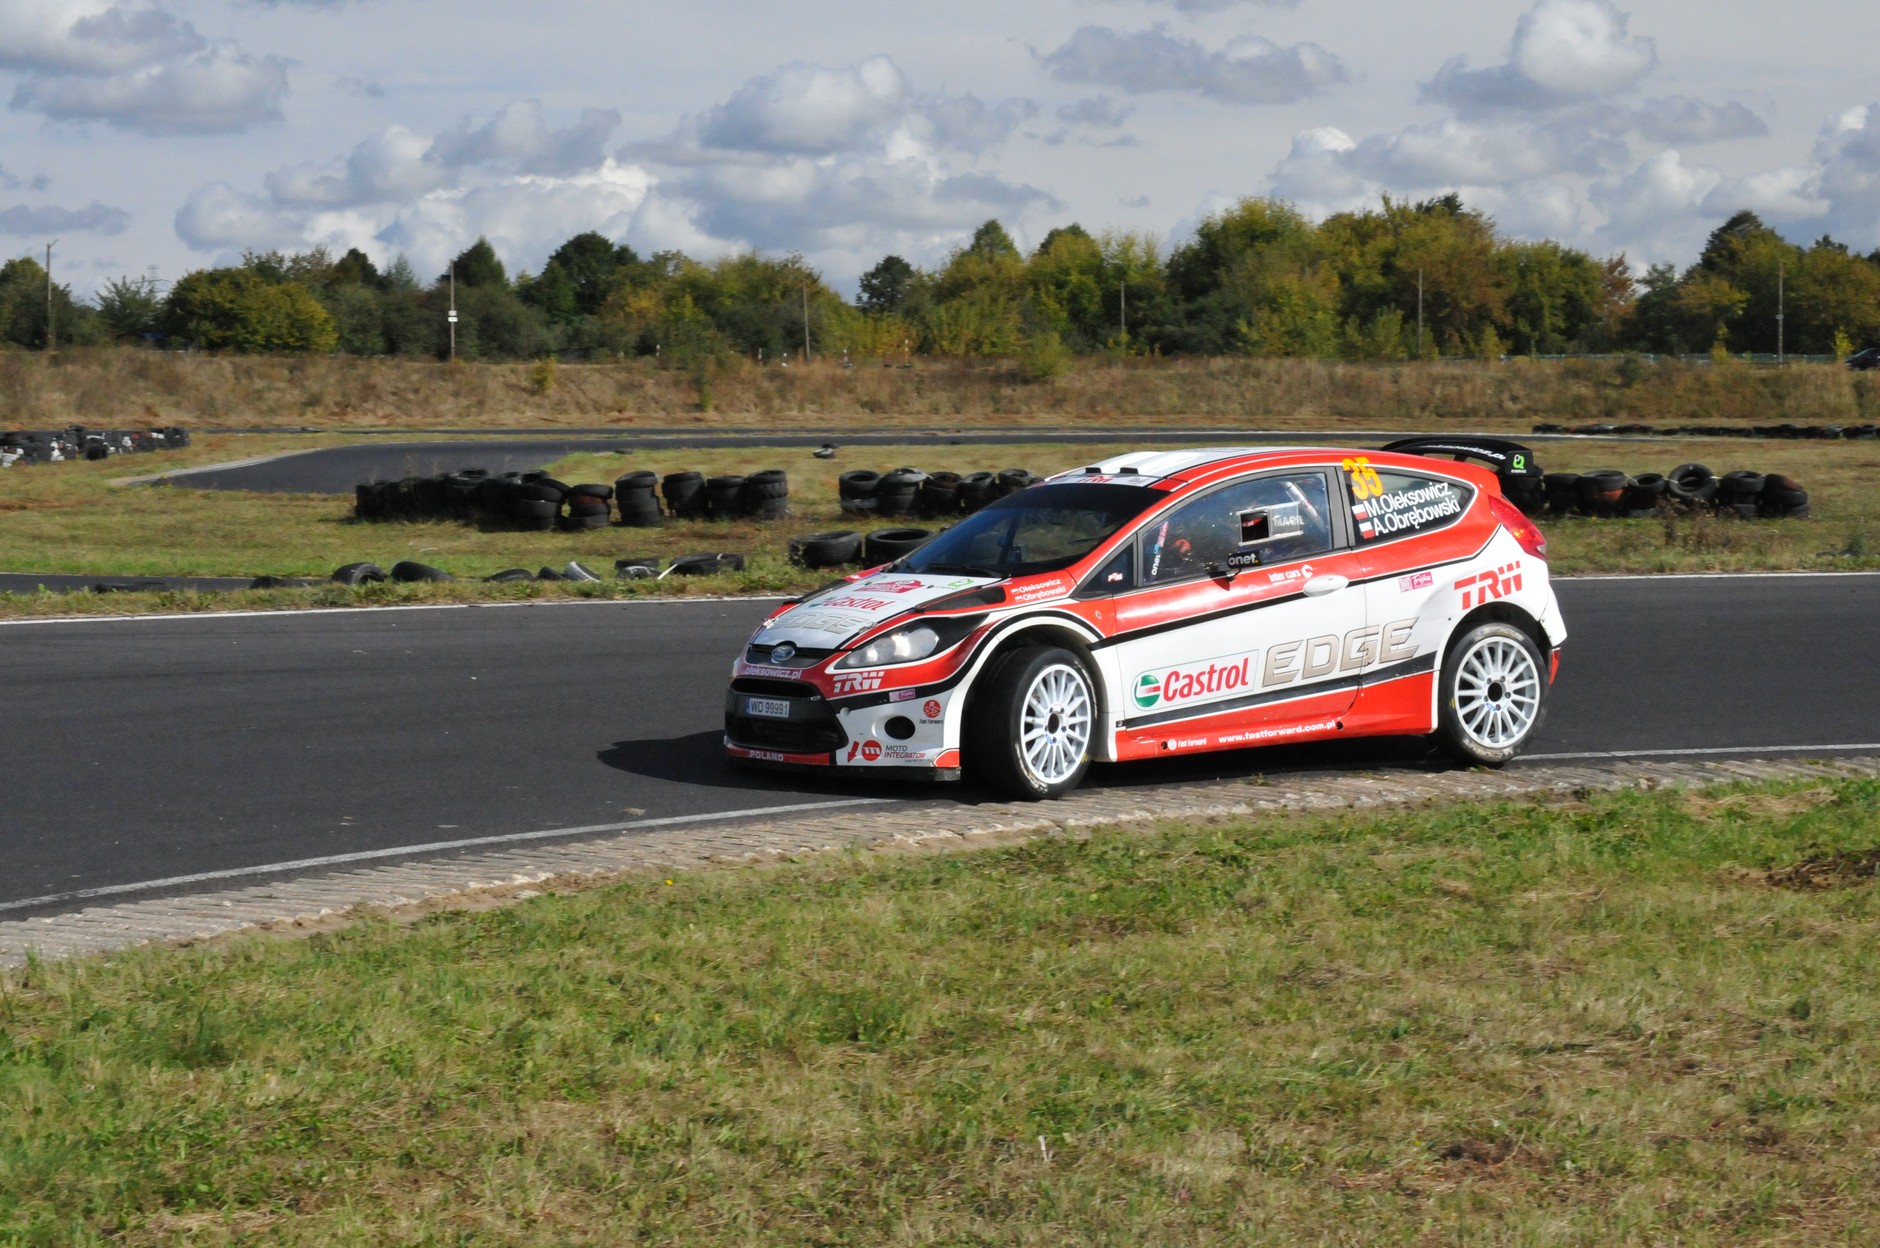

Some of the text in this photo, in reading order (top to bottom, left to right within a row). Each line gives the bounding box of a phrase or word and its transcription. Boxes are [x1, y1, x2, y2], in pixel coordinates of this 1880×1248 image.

[1342, 456, 1383, 500] 35
[1364, 482, 1452, 518] M.Oleksowicz
[1372, 495, 1461, 537] A.Obrębowski
[1454, 561, 1523, 610] TRW
[1262, 616, 1420, 688] EDGE
[744, 664, 803, 680] oleksowicz.pl
[832, 671, 885, 693] TRW
[1163, 657, 1250, 702] Castrol
[750, 699, 789, 715] WD 99991
[1218, 720, 1336, 744] www.fastforward.com.pl
[750, 750, 785, 761] POLAND
